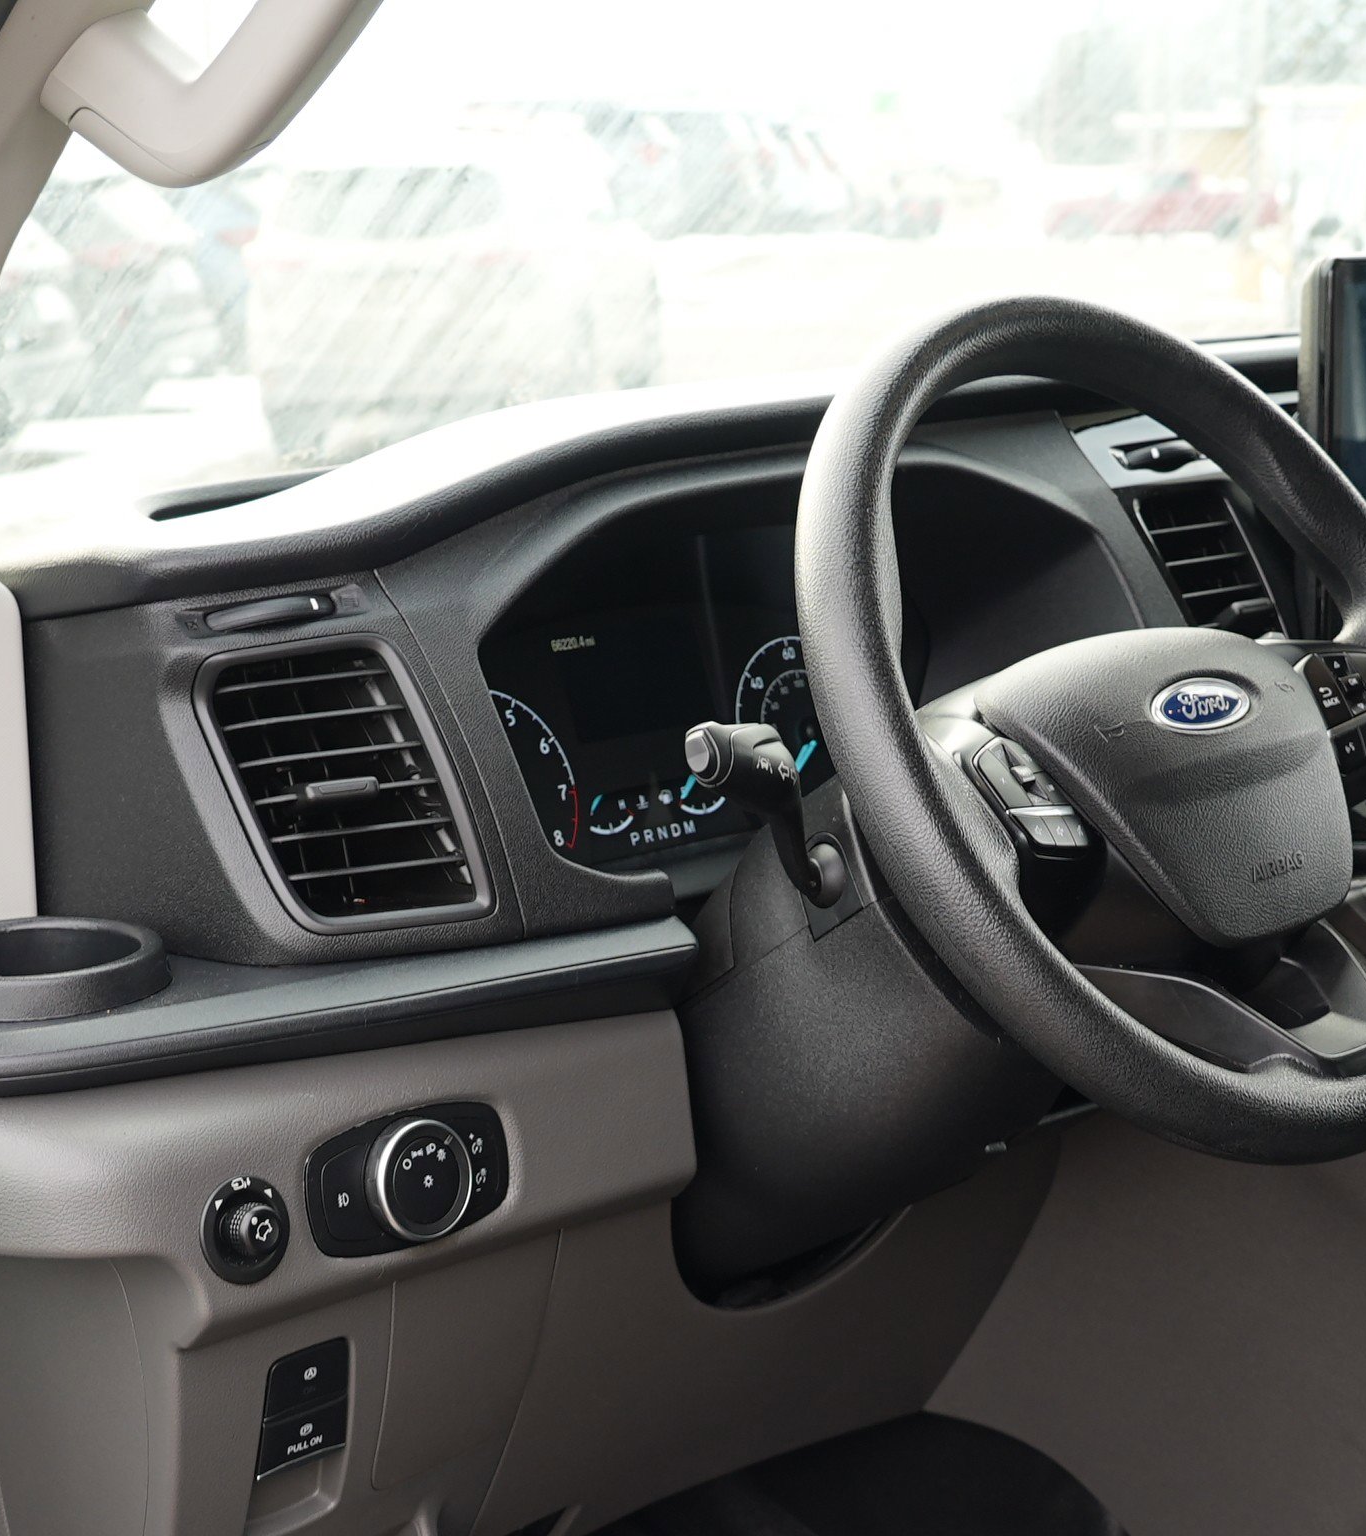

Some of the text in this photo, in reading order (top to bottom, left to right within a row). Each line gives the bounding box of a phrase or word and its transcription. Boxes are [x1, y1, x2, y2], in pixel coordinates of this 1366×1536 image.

[781, 646, 796, 661] 60
[750, 676, 764, 690] 40
[1177, 688, 1230, 720] Ford
[1322, 697, 1341, 709] BACK
[504, 709, 516, 727] 5
[539, 737, 550, 755] 6
[557, 784, 567, 801] 7
[553, 829, 565, 847] 8
[1251, 849, 1305, 884] AIRBAG
[287, 1434, 323, 1455] PULL ON
